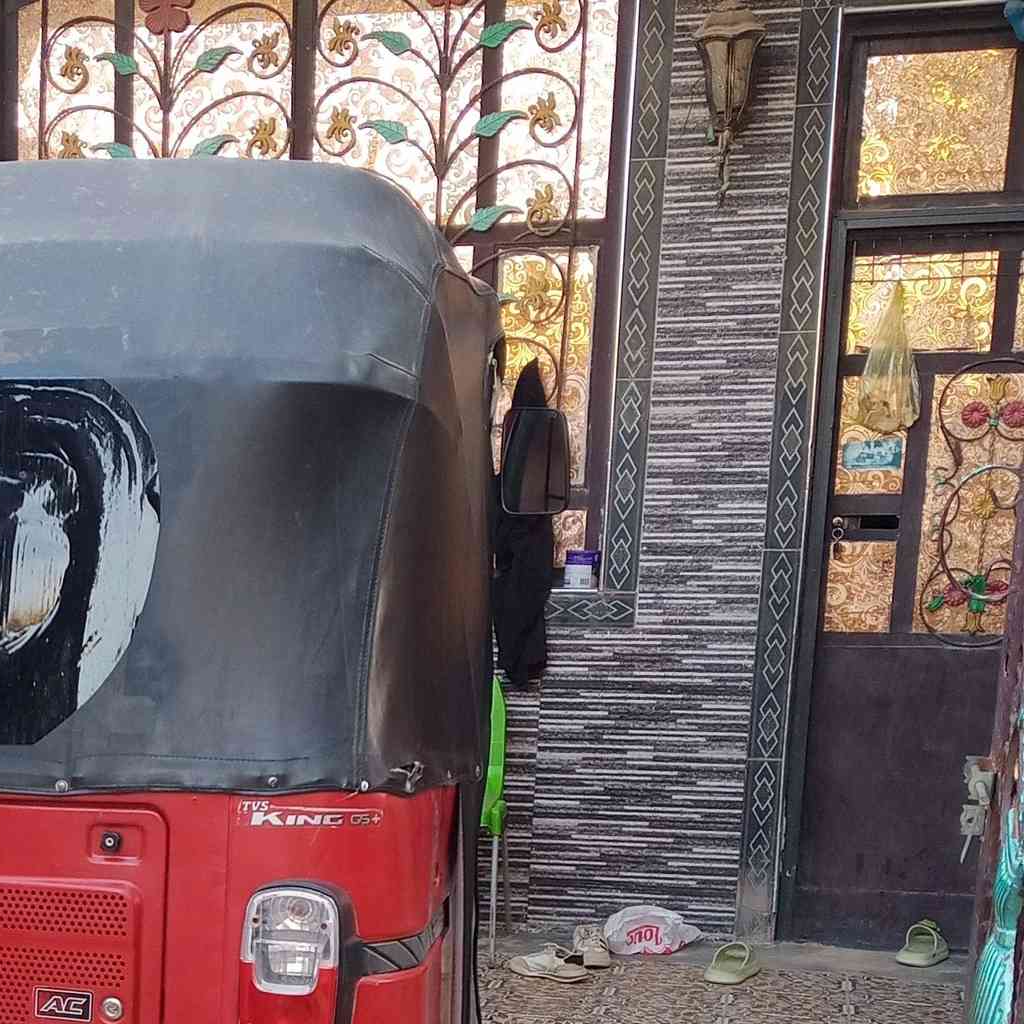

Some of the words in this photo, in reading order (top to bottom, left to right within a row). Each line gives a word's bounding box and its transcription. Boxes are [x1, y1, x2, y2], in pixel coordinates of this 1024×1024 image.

[242, 800, 270, 811] TVS
[251, 811, 345, 826] KING
[39, 995, 88, 1015] AC
